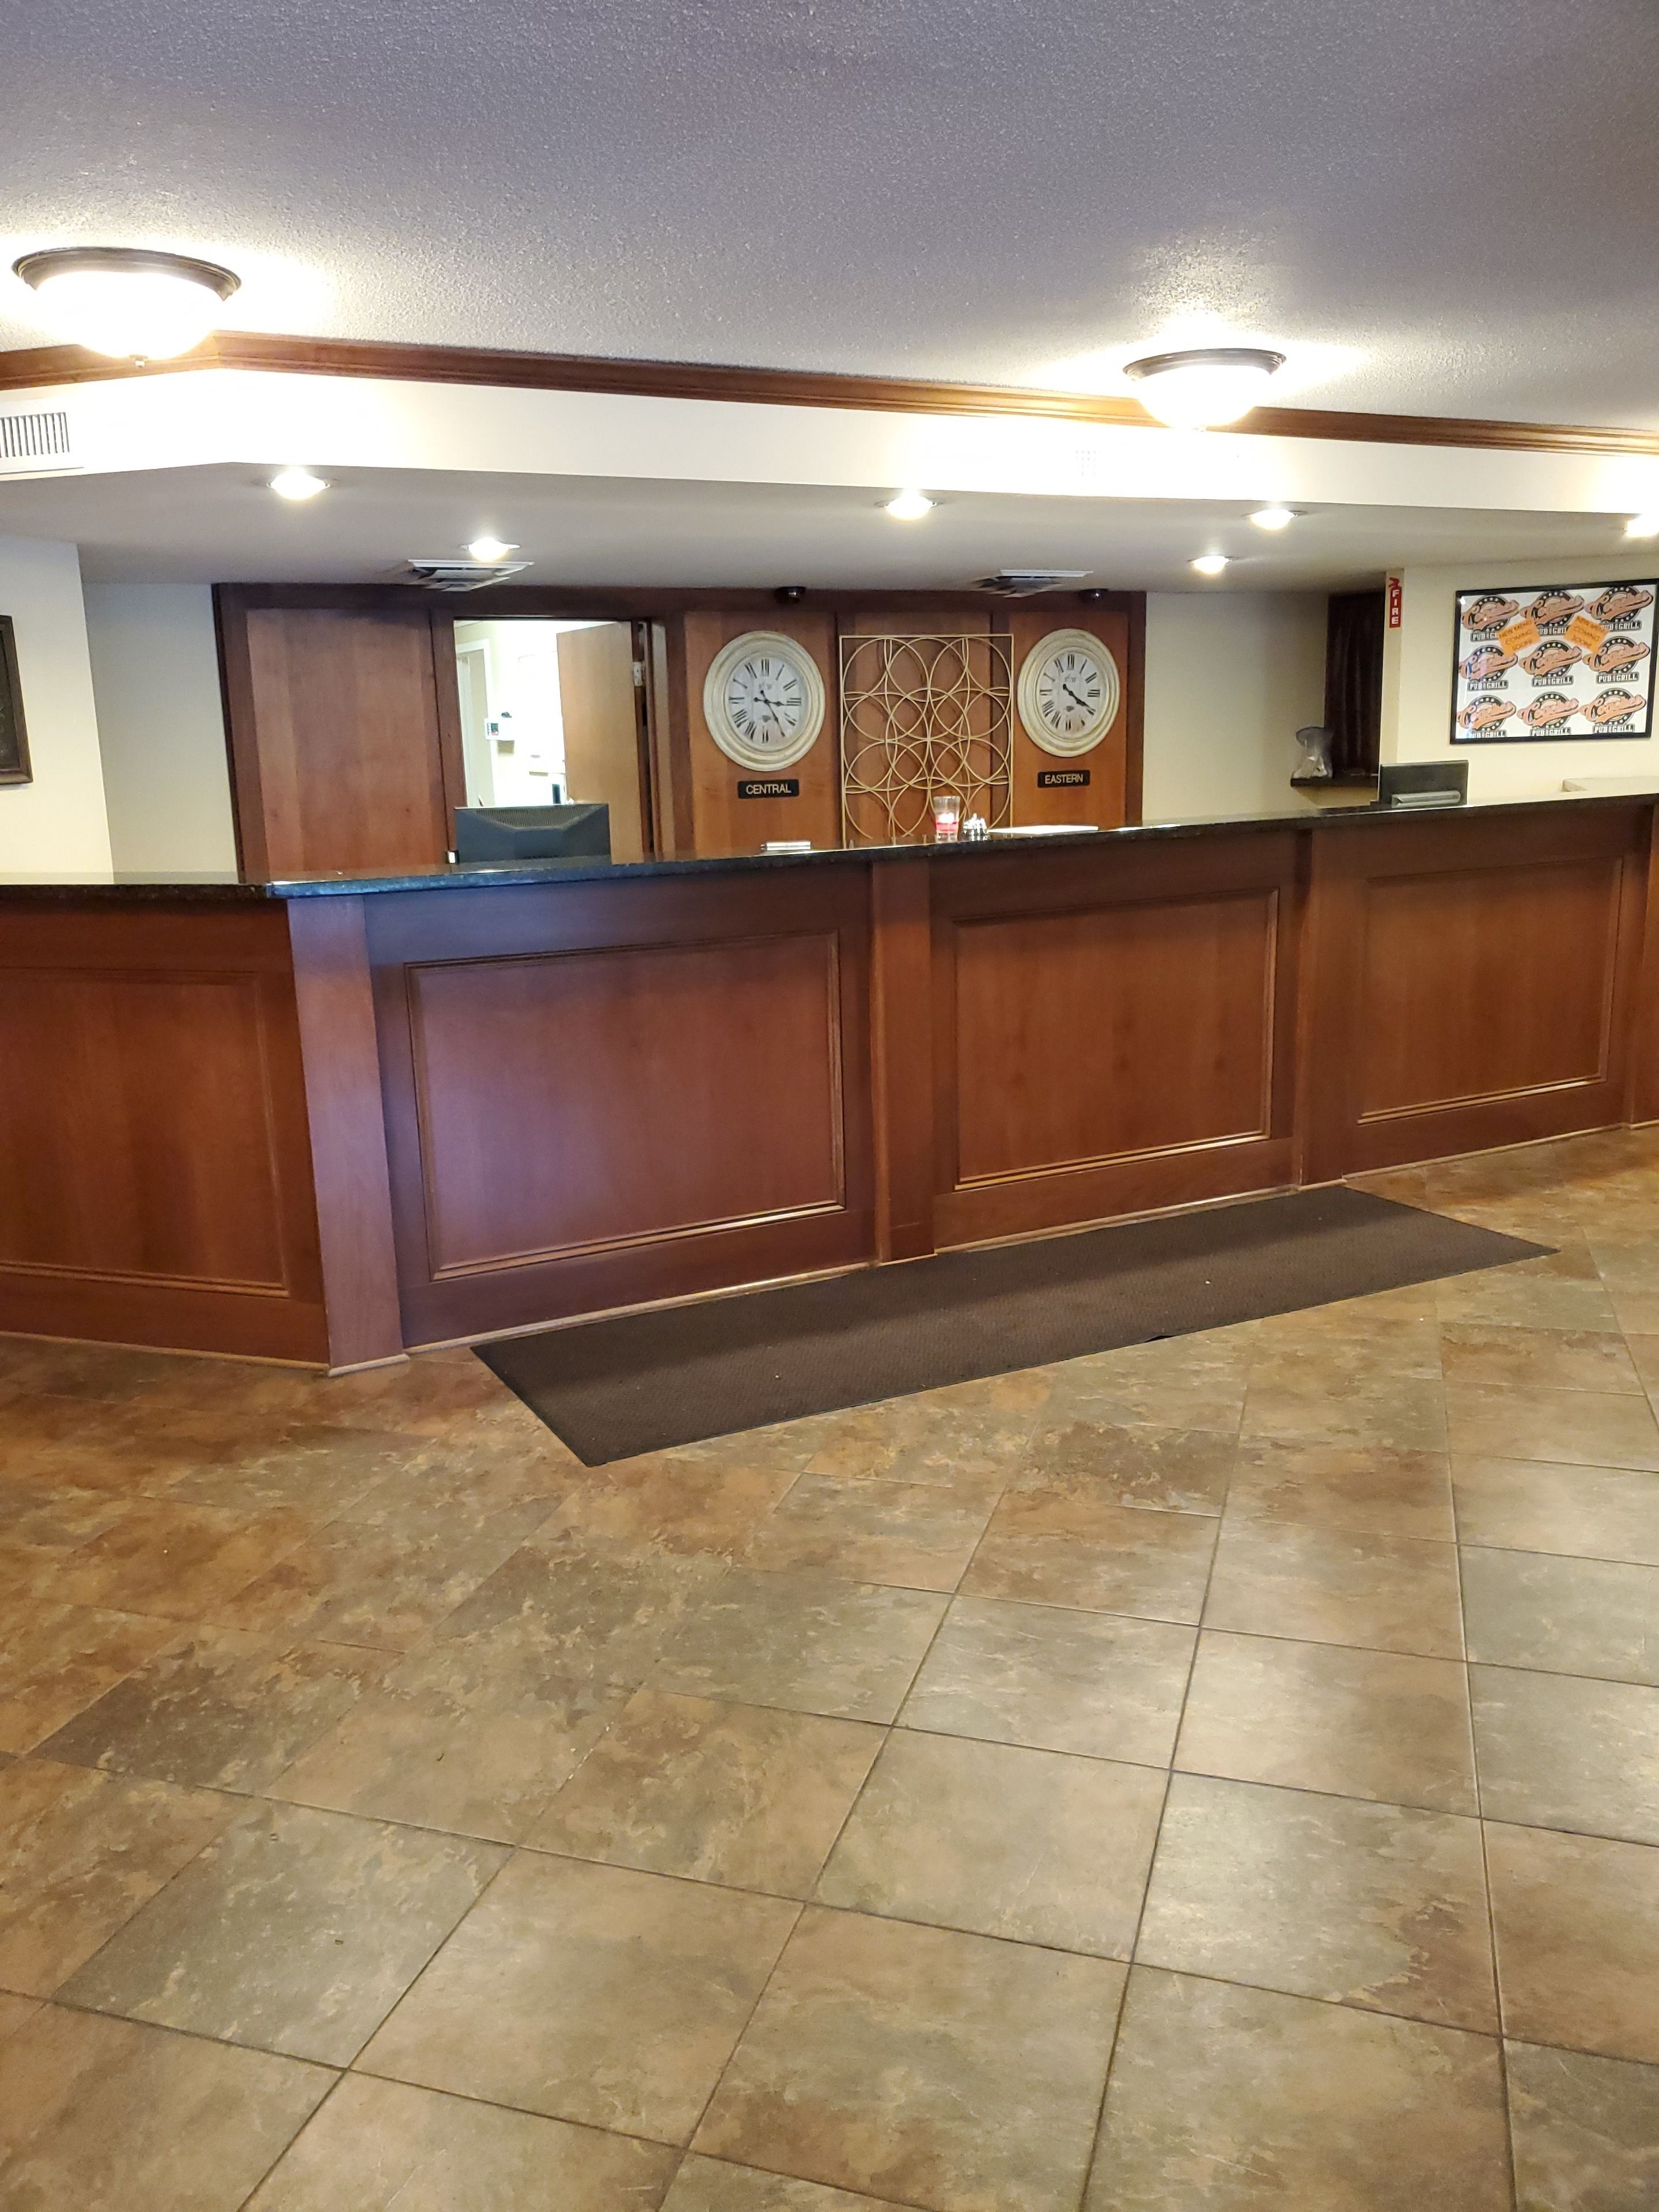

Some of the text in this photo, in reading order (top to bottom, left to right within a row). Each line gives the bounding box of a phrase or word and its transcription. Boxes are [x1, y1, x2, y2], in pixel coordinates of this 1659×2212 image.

[1392, 589, 1400, 624] FIRE
[1044, 773, 1084, 785] EASTERN
[745, 783, 792, 794] CENTRAL
